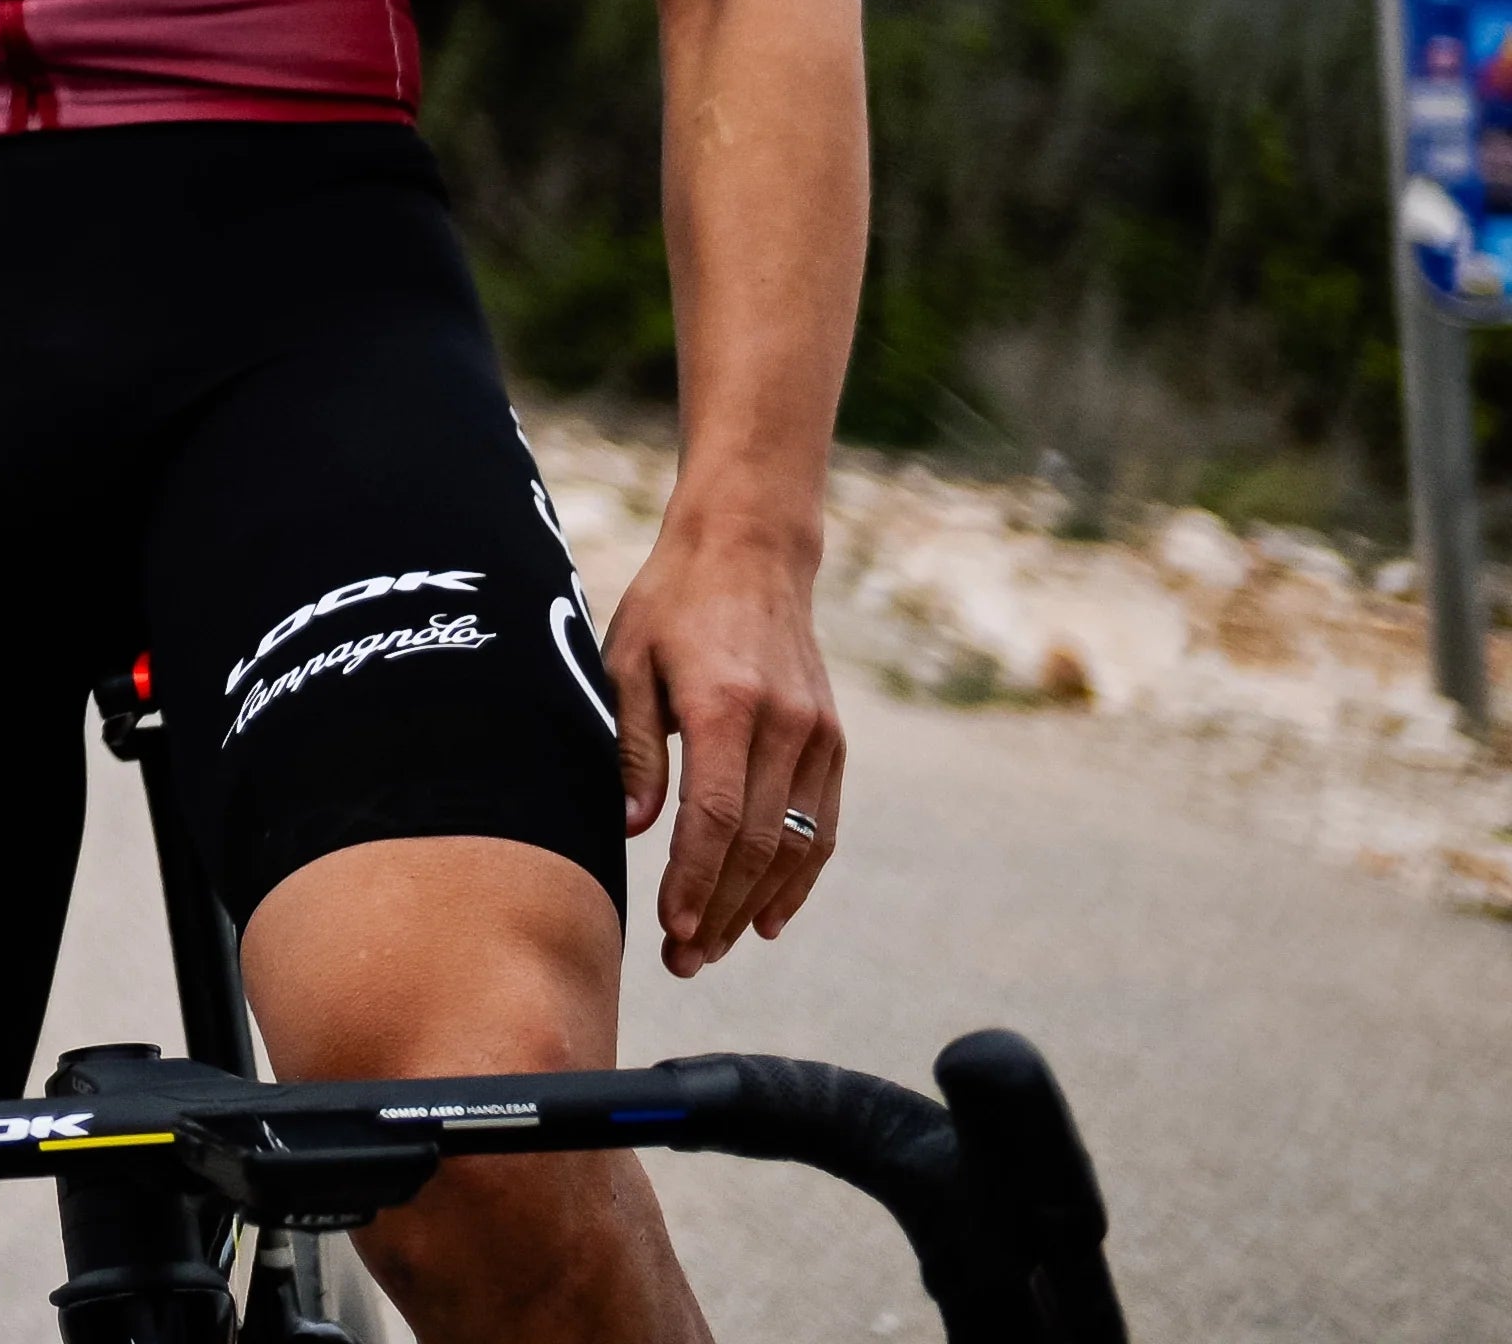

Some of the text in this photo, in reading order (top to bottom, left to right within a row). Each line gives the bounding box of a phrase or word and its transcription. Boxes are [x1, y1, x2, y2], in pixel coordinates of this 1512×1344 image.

[222, 613, 497, 750] Campagnolo
[225, 571, 487, 696] LOOK
[429, 1105, 465, 1117] AERO
[466, 1102, 538, 1116] HANDLEBAR
